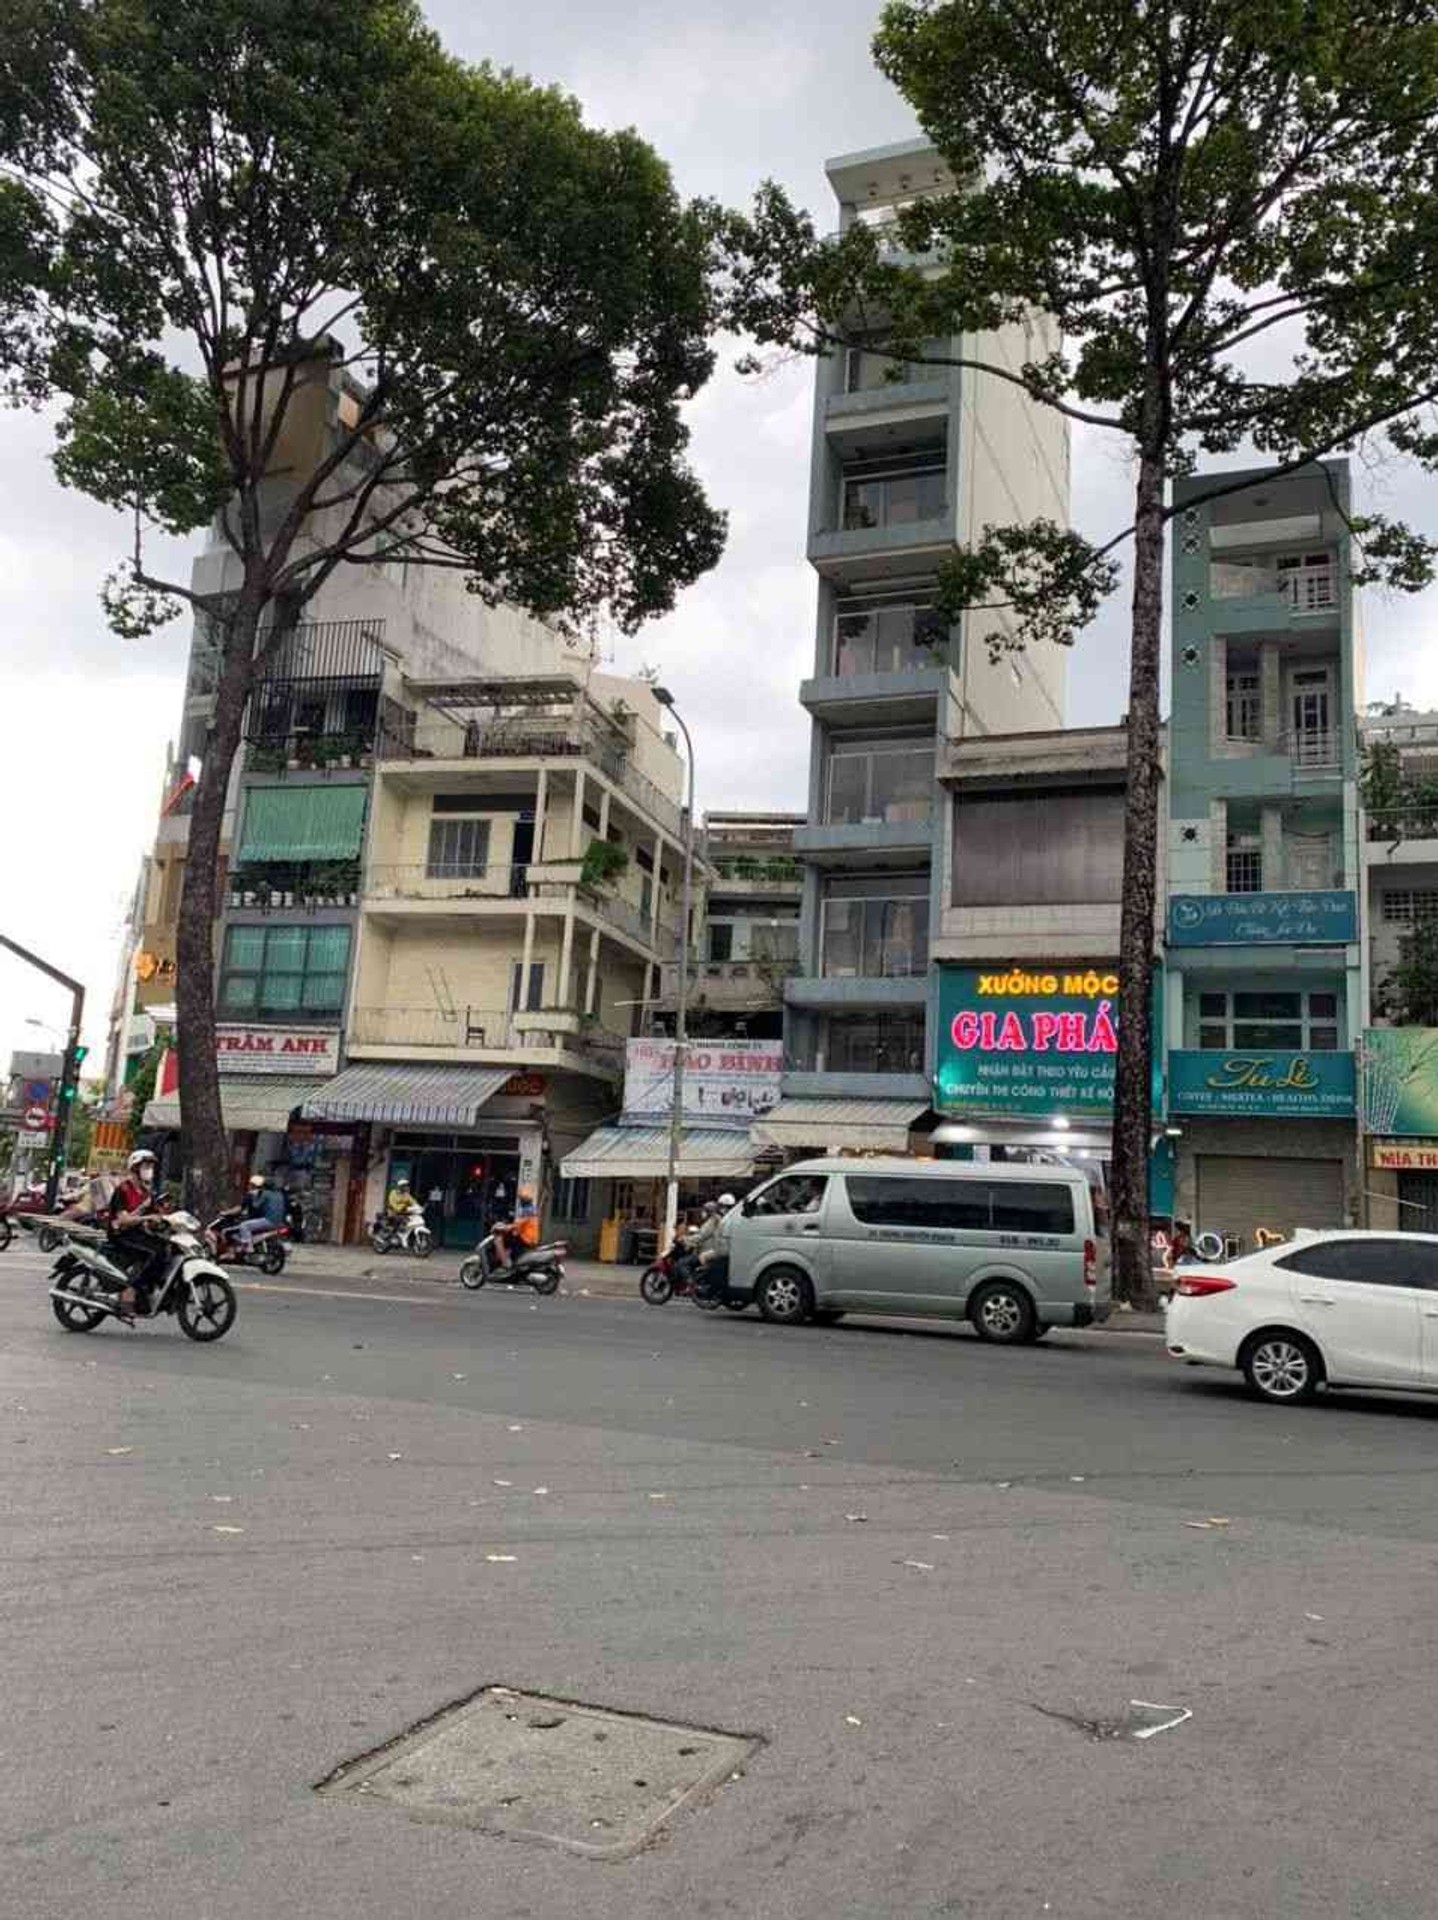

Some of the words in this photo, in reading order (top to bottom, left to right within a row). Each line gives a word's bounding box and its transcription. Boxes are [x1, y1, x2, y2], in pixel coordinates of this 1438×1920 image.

[978, 967, 1058, 995] XƯỞNG
[1063, 969, 1120, 998] MỘC
[951, 1010, 1028, 1051] GIA
[1032, 999, 1119, 1052] PHÁ
[281, 1038, 328, 1053] ANH
